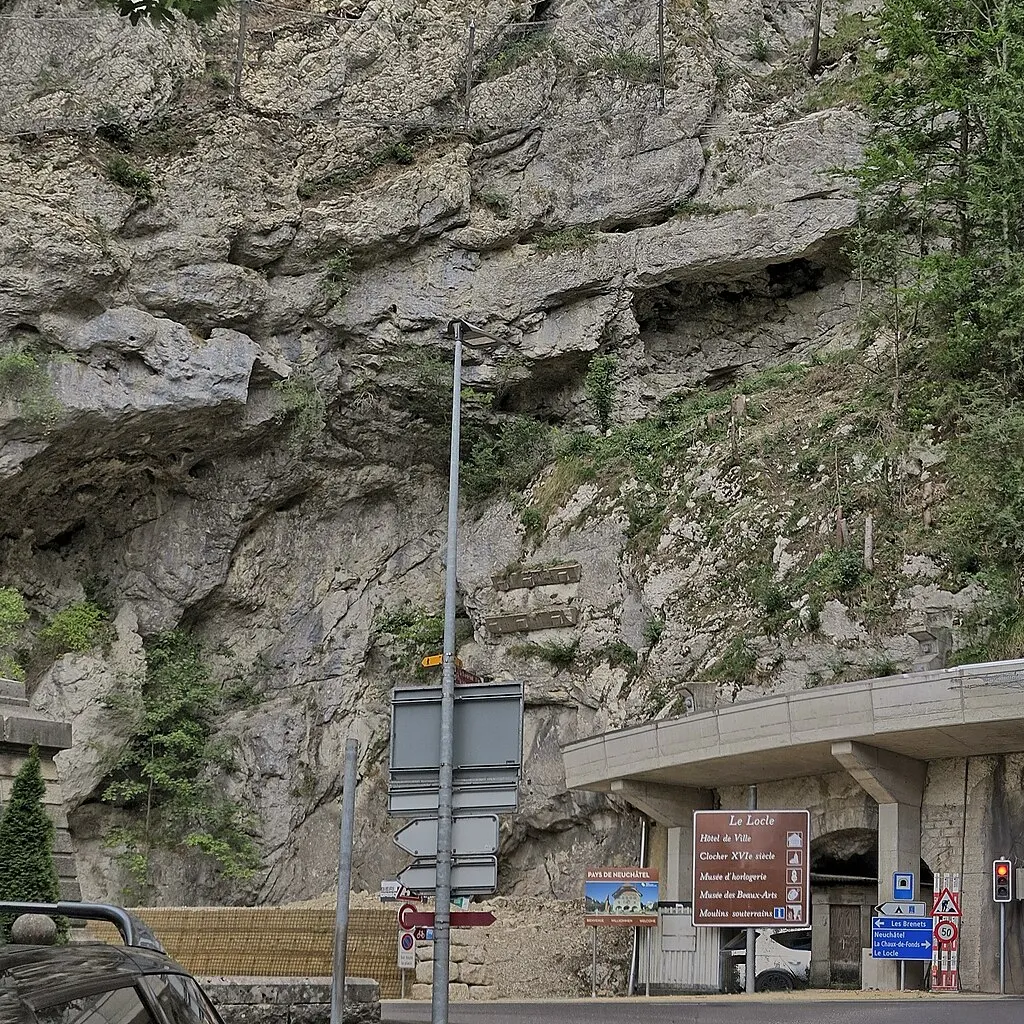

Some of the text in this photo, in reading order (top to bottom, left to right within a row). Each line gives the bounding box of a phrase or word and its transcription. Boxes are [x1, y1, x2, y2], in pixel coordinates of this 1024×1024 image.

[729, 815, 775, 826] Le Locle
[700, 834, 752, 842] Hôtel de Ville
[700, 852, 775, 860] Clocher XVIe siècle
[700, 872, 767, 882] Musée d'horlogerie
[700, 890, 777, 899] Musée des Beaux-Arts
[699, 909, 773, 917] Moulins souterrains
[941, 928, 952, 937] 50
